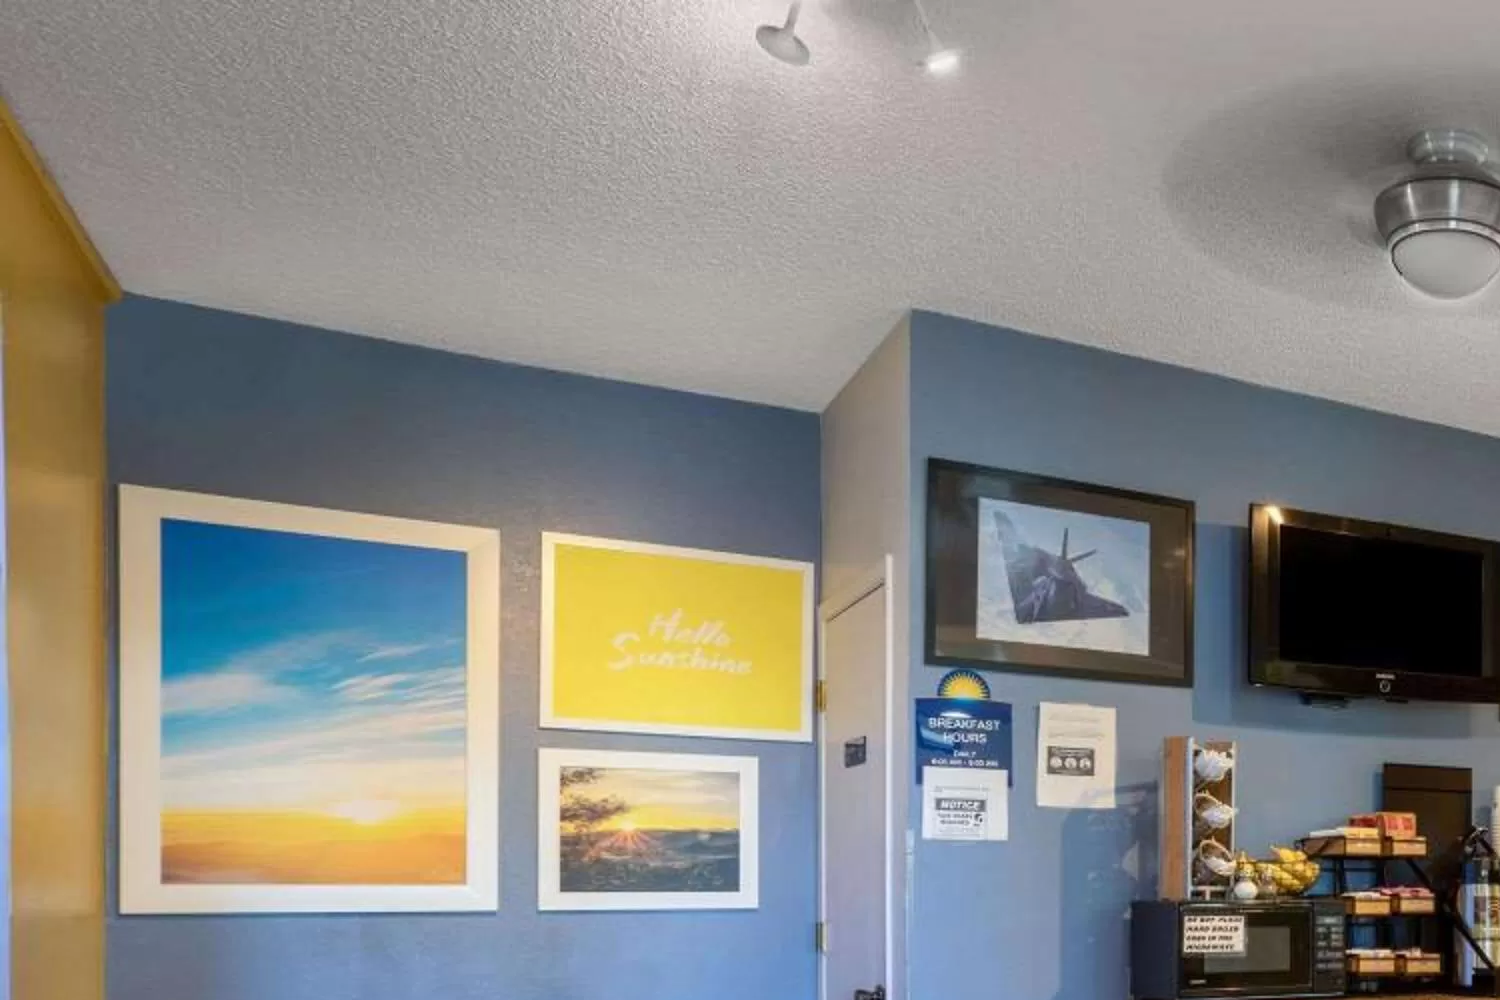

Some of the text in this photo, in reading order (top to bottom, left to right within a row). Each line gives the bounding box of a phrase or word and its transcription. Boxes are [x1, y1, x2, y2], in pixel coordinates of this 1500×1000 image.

[648, 607, 732, 647] Hello
[608, 631, 753, 674] Sunshine
[927, 716, 1001, 731] BREAKFAST
[943, 730, 988, 744] HOURS
[940, 799, 982, 812] NOTICE
